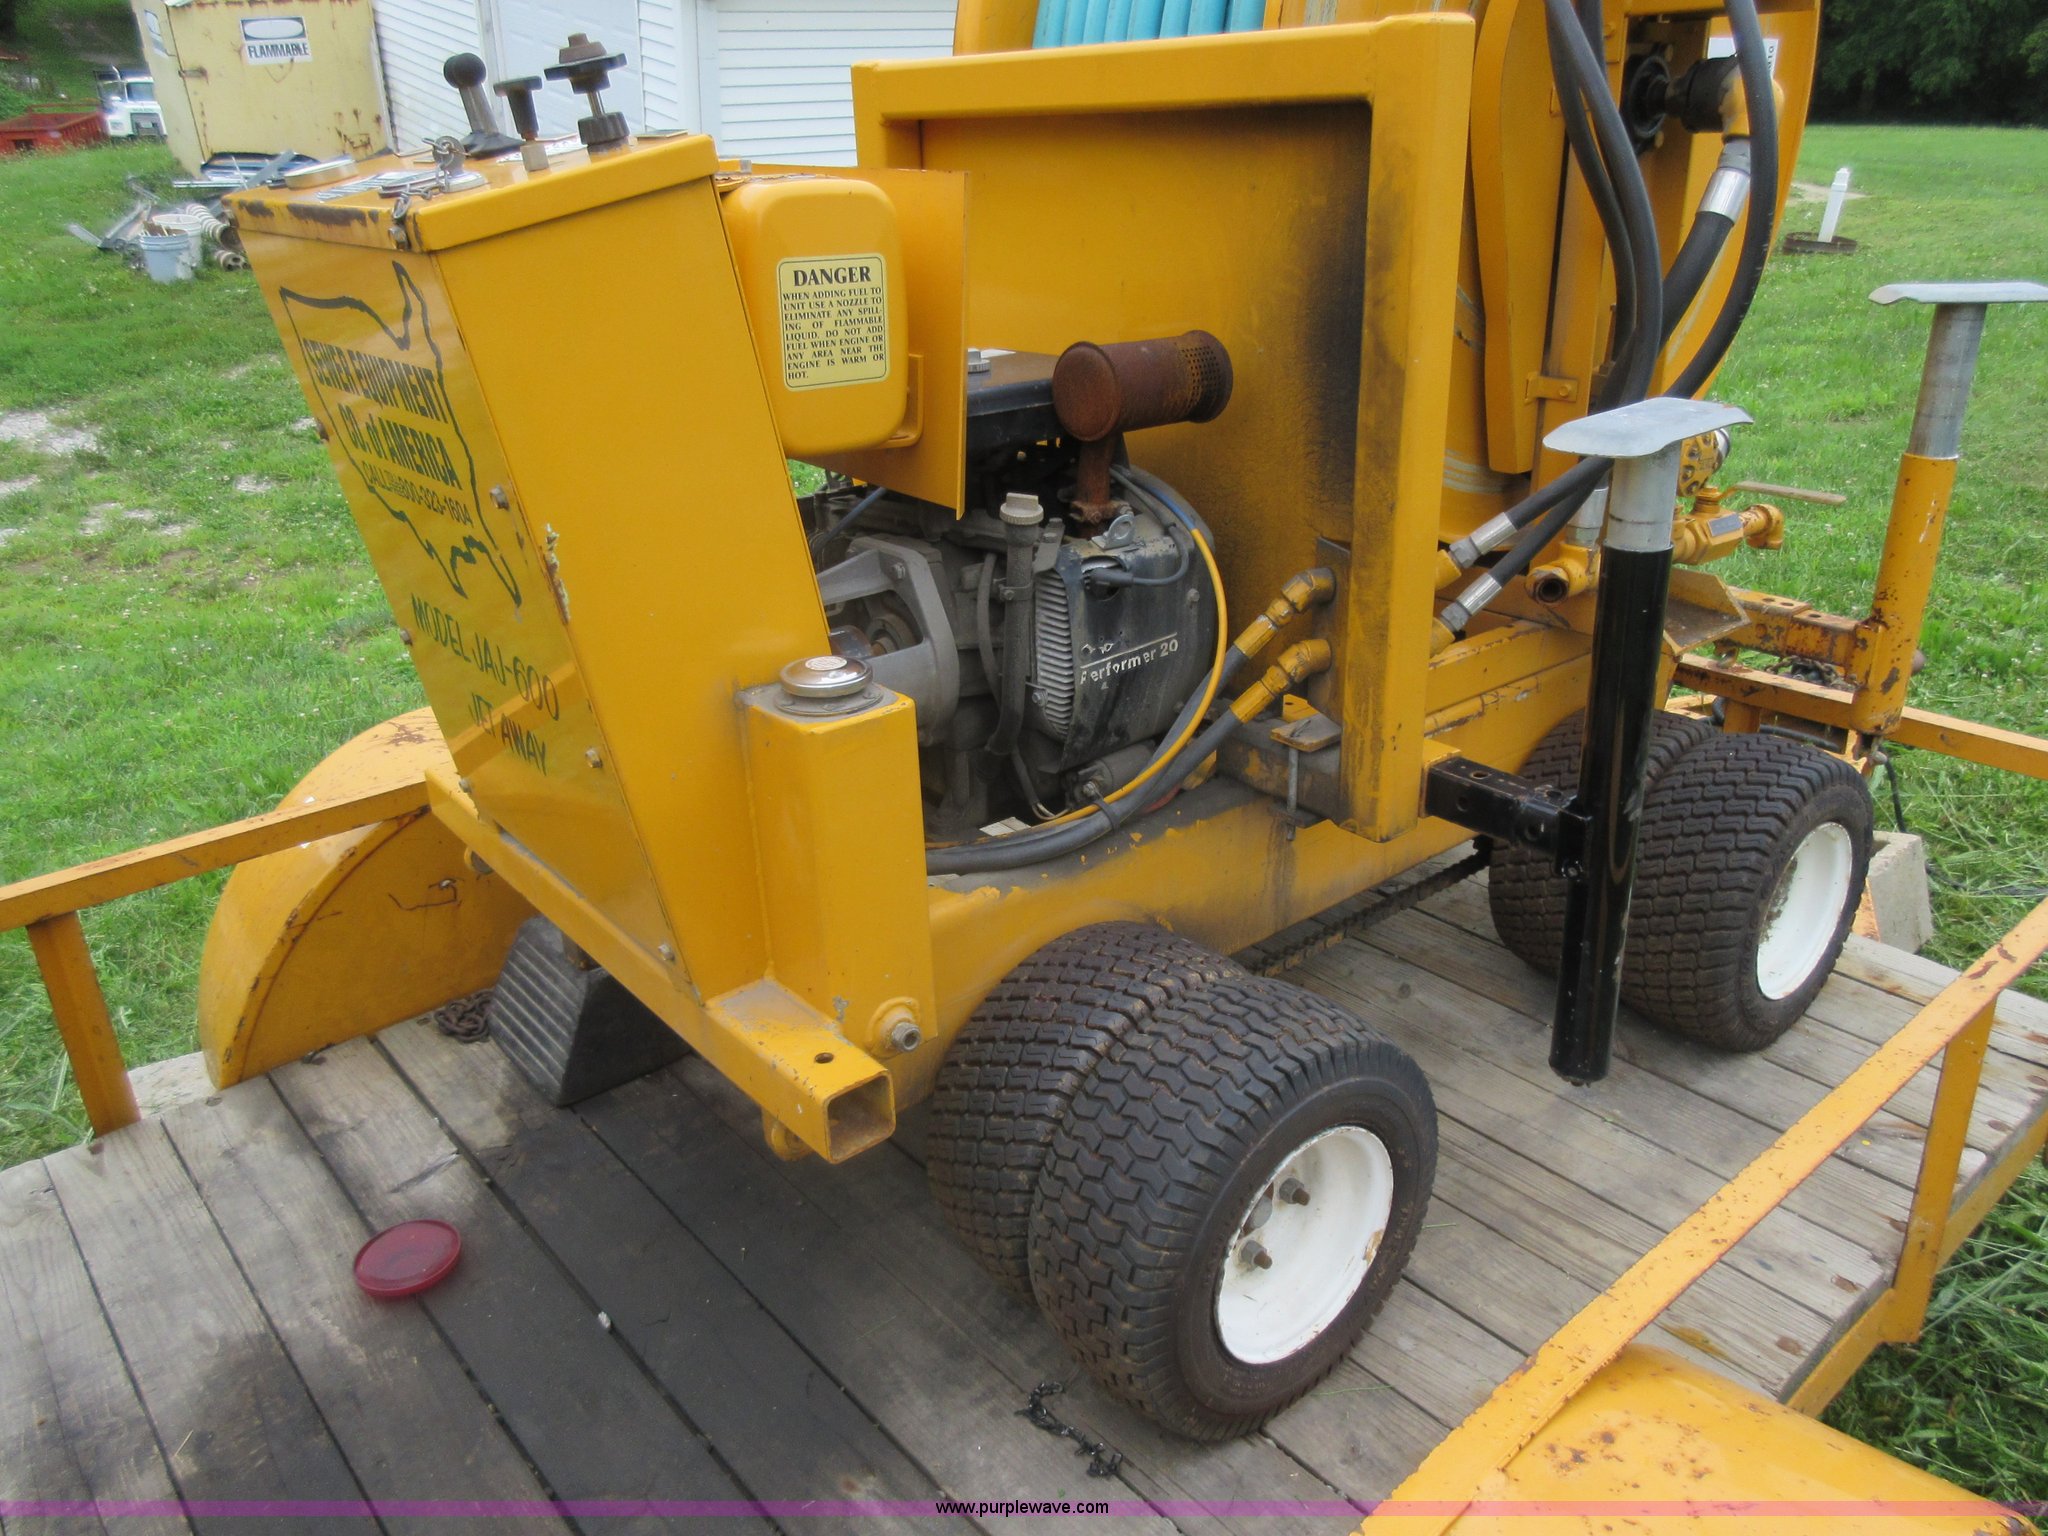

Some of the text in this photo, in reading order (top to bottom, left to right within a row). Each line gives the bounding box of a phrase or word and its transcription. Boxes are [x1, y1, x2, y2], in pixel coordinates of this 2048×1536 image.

[248, 43, 309, 58] FLAMMABLE
[793, 266, 871, 286] DANGER
[783, 287, 881, 300] WHEN ADDING FUEL TO
[783, 302, 806, 311] UNIT
[809, 301, 825, 309] USE
[836, 298, 868, 307] NOZZLE
[784, 306, 882, 321] ELIMINATE ANY SPILL-
[785, 316, 883, 331] ING OF FLAMMABLE
[826, 330, 838, 338] DO
[844, 328, 862, 336] NOT
[867, 326, 883, 334] ADD
[786, 342, 808, 351] FUEL
[810, 340, 836, 348] WHEN
[840, 336, 868, 346] ENGINE
[787, 344, 884, 360] ANY AREA NEAR THE
[788, 360, 820, 370] ENGINE
[842, 356, 866, 364] WARM
[303, 338, 448, 424] SEWER EQUIPMENT
[788, 371, 809, 380] HOT.
[338, 402, 372, 454] CO.
[366, 413, 388, 460] of
[378, 416, 463, 491] AMERICA
[362, 461, 393, 492] CALL
[412, 592, 559, 721] MODEL JAJ-600
[1080, 639, 1179, 685] Performer 20
[468, 692, 547, 777] JET AWAY
